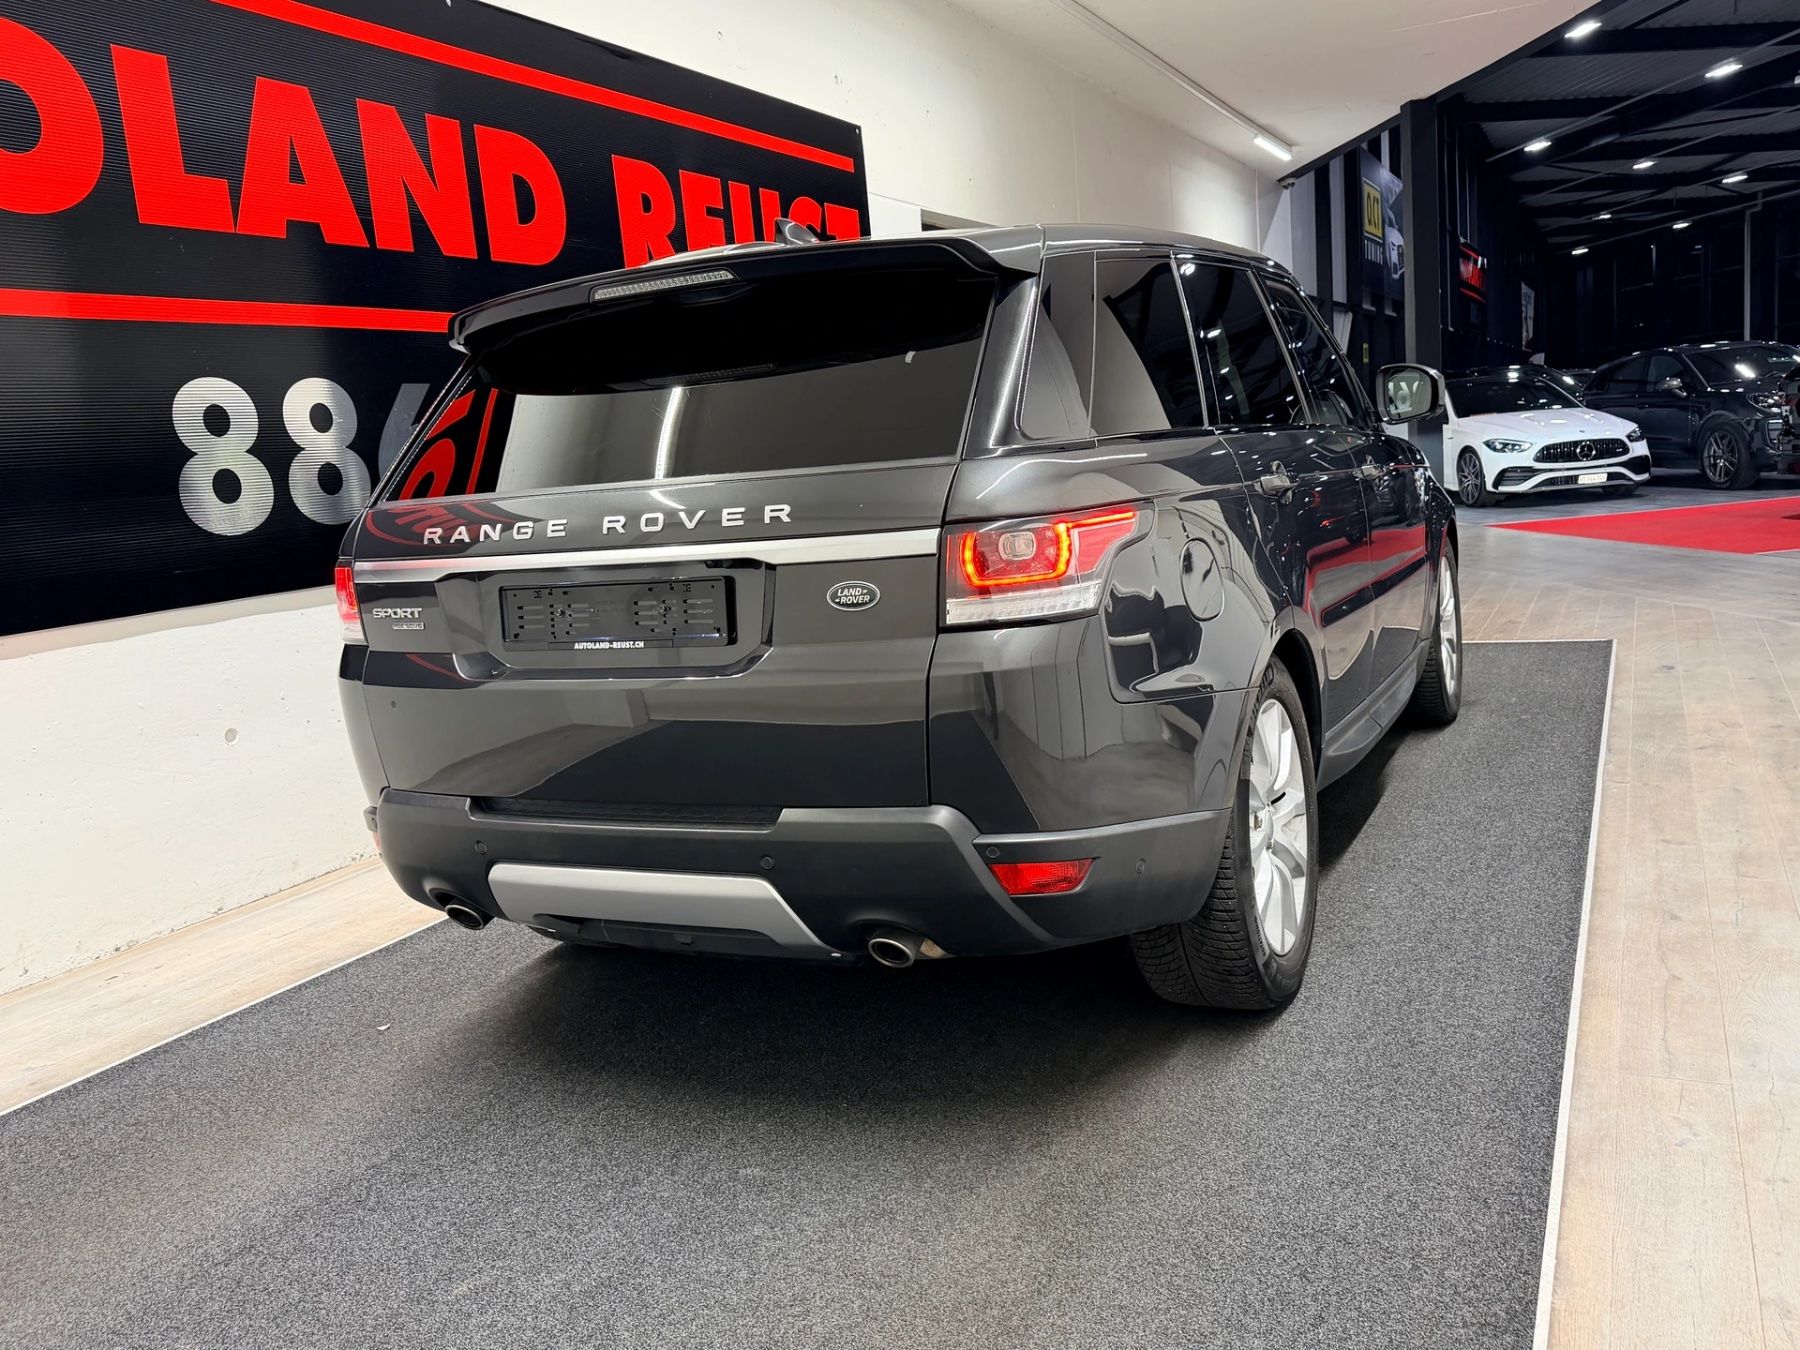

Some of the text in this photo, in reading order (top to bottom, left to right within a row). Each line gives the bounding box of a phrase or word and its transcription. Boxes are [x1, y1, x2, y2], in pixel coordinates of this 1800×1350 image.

[423, 518, 568, 545] RANGE
[602, 504, 792, 534] ROVER
[837, 587, 862, 596] LAND
[840, 595, 870, 604] ROVER
[372, 607, 423, 619] SPORT
[574, 641, 644, 650] AUTOLAND-REUST.CH
